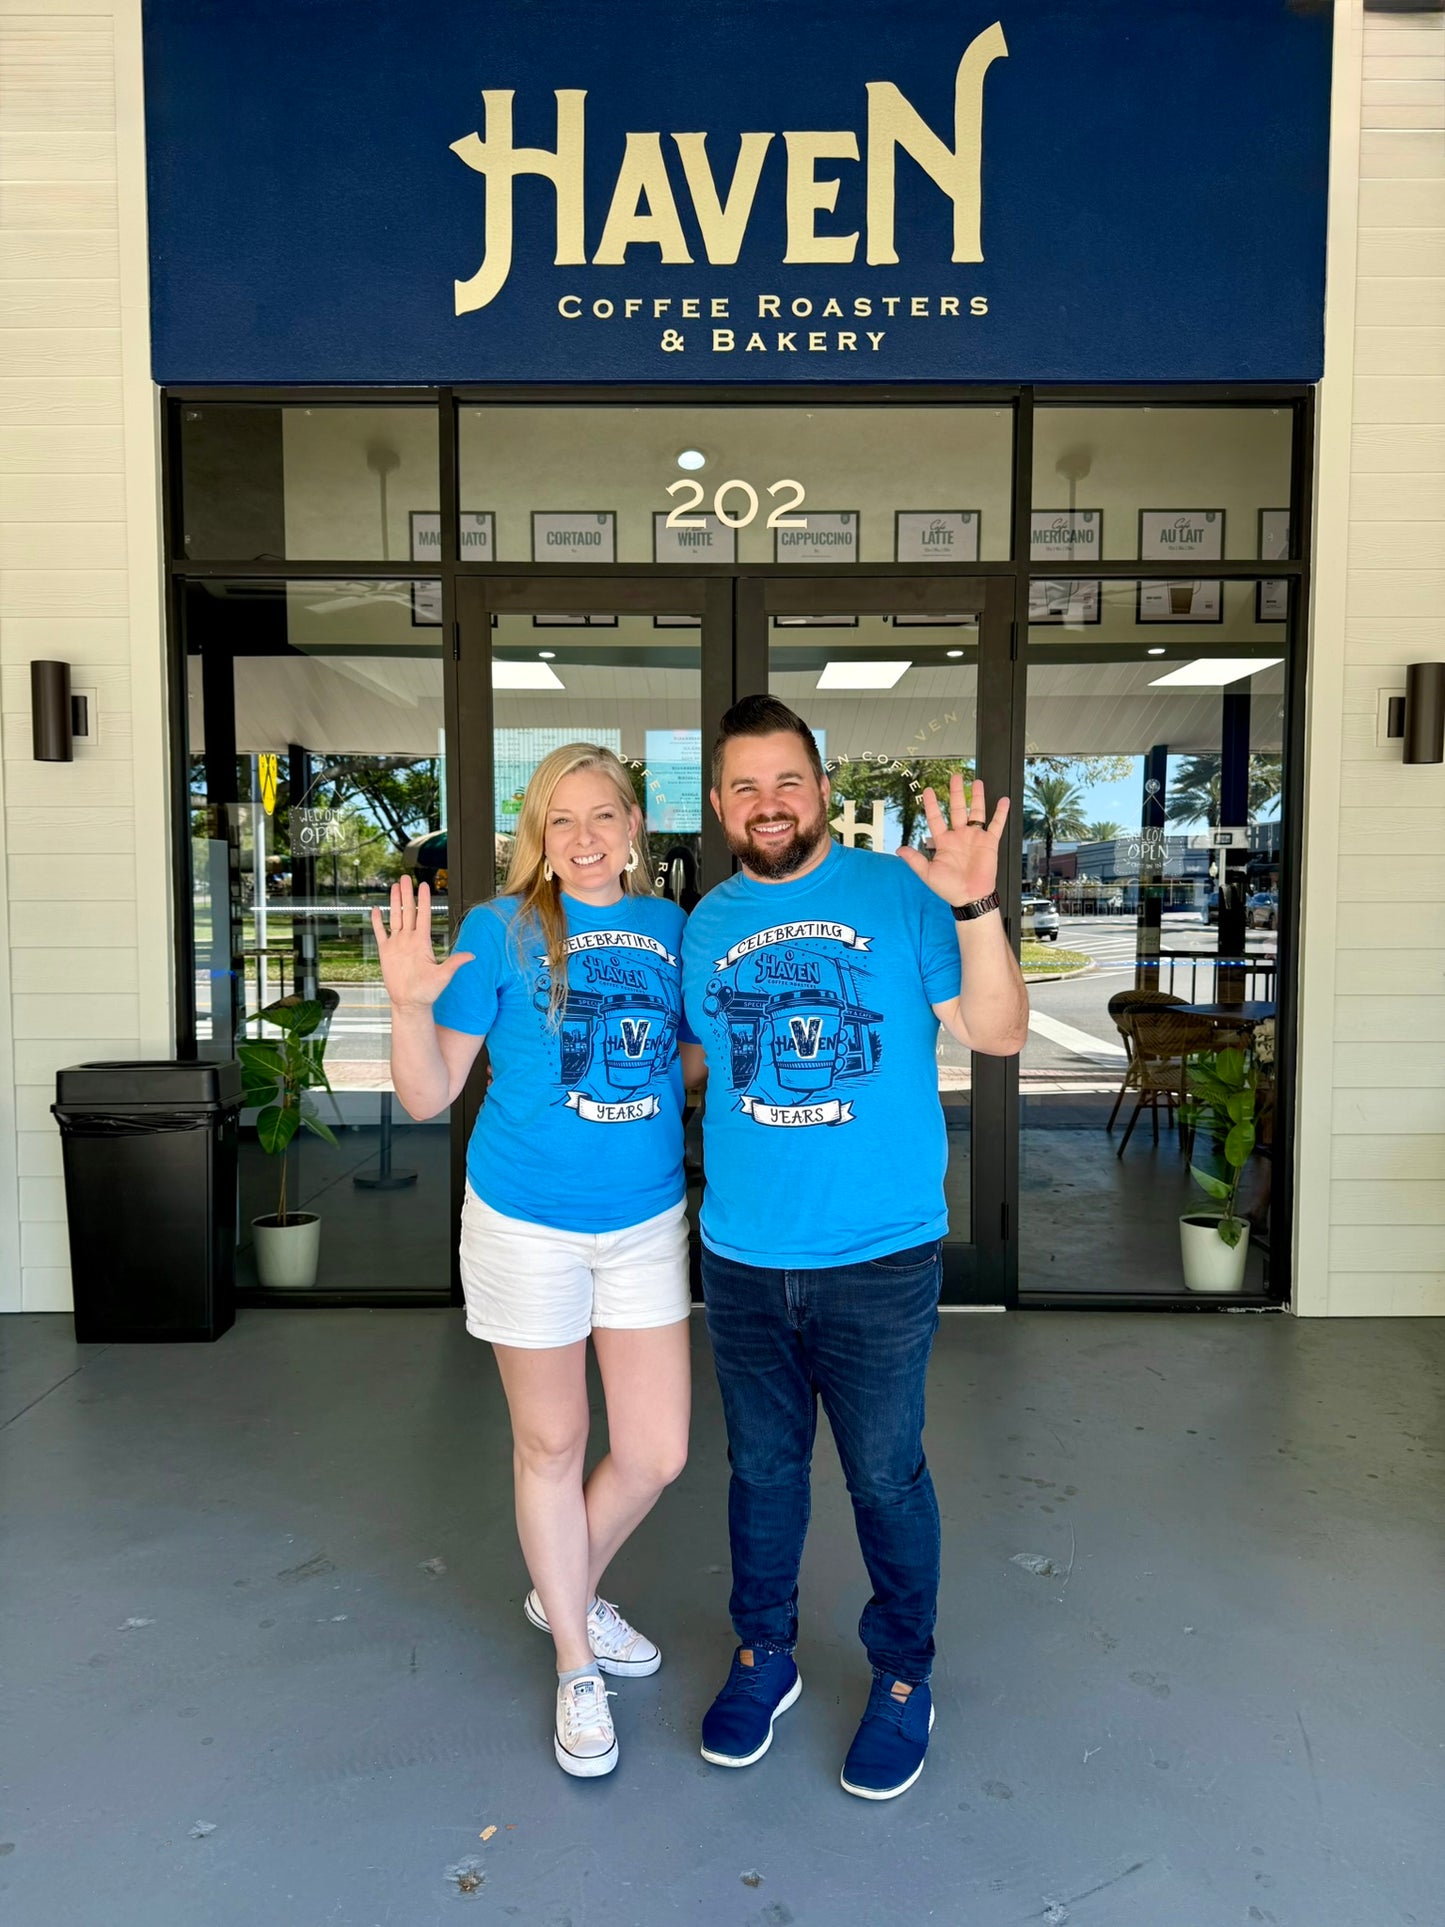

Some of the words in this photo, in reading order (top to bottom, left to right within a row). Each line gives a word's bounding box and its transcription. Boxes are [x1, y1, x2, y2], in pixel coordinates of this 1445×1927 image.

[448, 20, 1009, 317] HAVEN
[558, 295, 730, 319] COFFEE
[758, 294, 990, 318] ROASTERS
[660, 328, 684, 352] &
[712, 328, 887, 351] BAKERY
[665, 479, 808, 529] 202
[546, 531, 602, 546] CORTADO
[678, 532, 713, 546] WHITE
[781, 531, 852, 546] CAPPUCCINO
[922, 530, 954, 545] LATTE
[1031, 529, 1094, 544] MERICANO
[1160, 529, 1177, 543] AU
[1179, 529, 1205, 543] LAIT
[905, 711, 959, 757] AVEN
[618, 753, 667, 805] OFFEE
[862, 751, 925, 806] COFFEE
[300, 826, 346, 844] OPEN
[1127, 843, 1169, 860] OPEN
[737, 923, 843, 954] CELEBRATING
[583, 955, 648, 990] HAVEN
[755, 952, 821, 985] HAVEN
[597, 1103, 644, 1120] YEARS
[770, 1107, 824, 1124] YEARS
